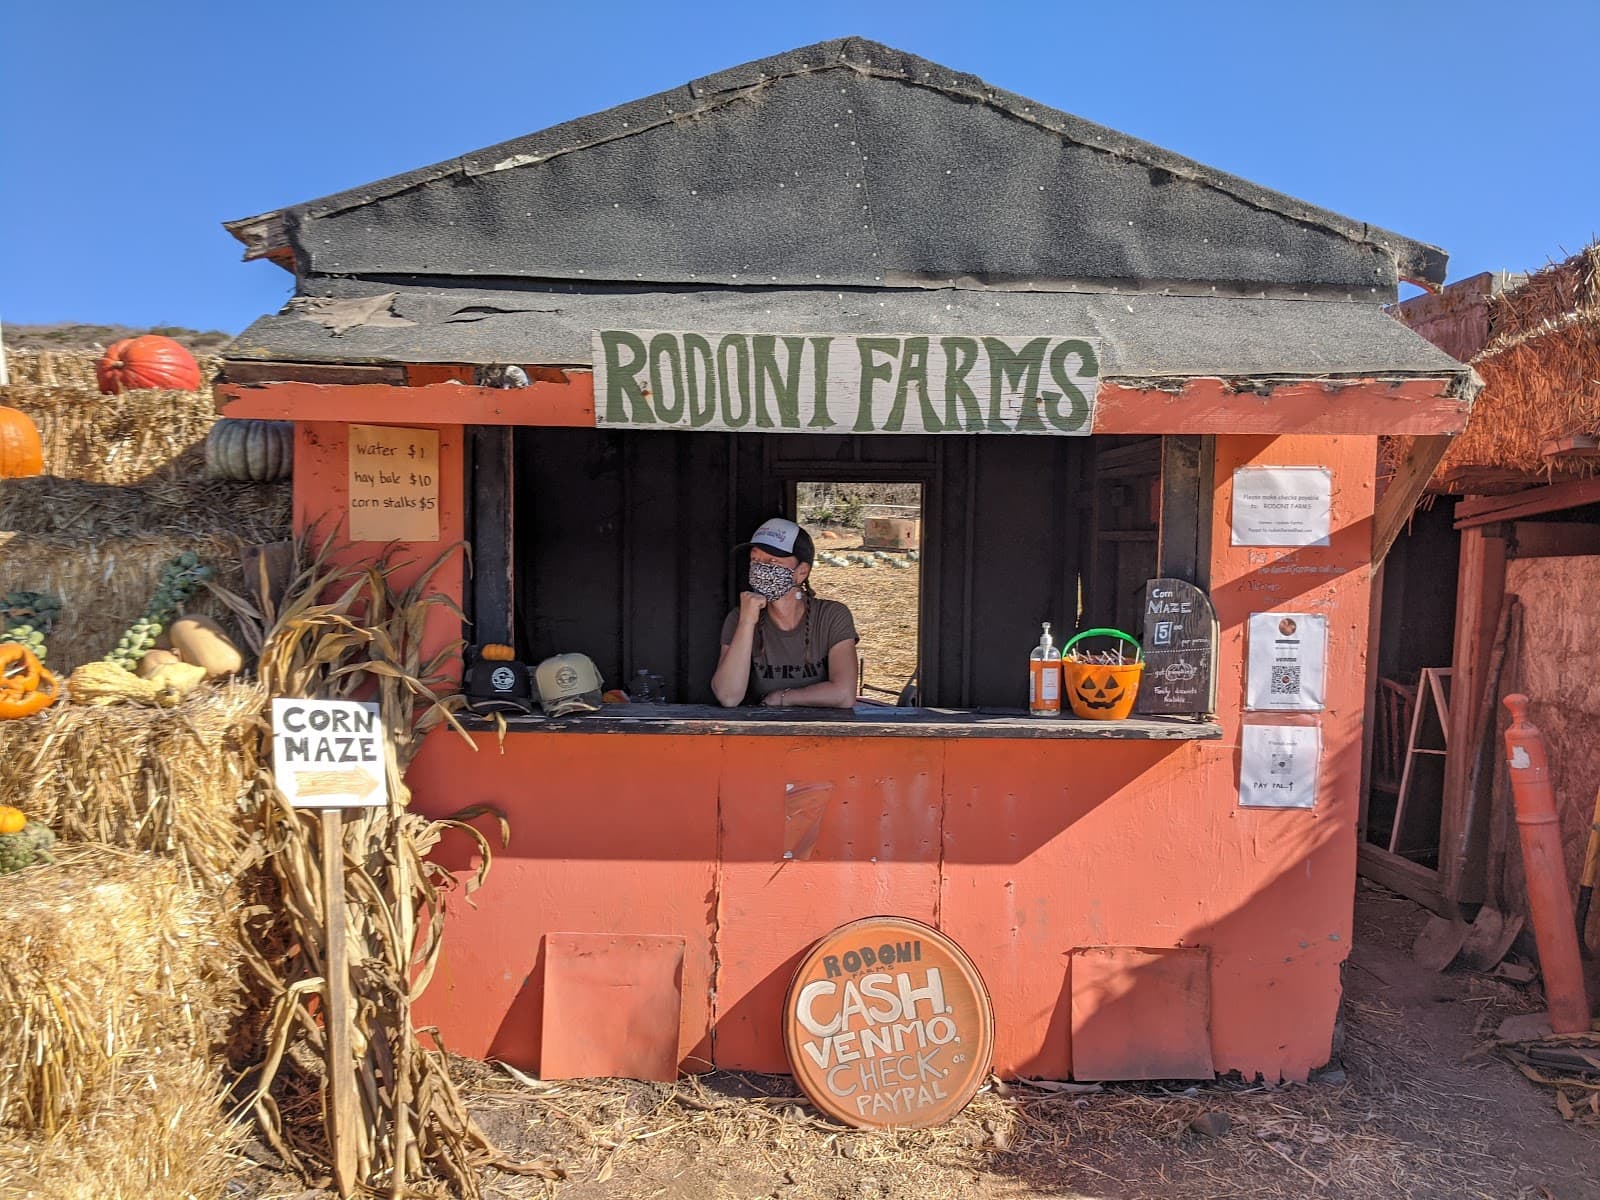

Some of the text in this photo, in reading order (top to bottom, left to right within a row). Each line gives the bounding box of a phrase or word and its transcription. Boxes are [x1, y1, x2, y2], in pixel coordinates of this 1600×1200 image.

[600, 330, 1100, 434] RODONI FARMS
[354, 470, 432, 487] hay bale $10
[352, 496, 436, 511] corn stalks $5
[1152, 588, 1173, 598] Corn
[1146, 600, 1192, 614] MAZE
[282, 706, 375, 733] CORN
[283, 736, 378, 763] MAZE
[1253, 781, 1268, 790] PAY
[802, 1016, 962, 1070] VENMO,
[826, 1047, 950, 1097] CHECK,
[855, 1081, 948, 1117] PAYPAL
